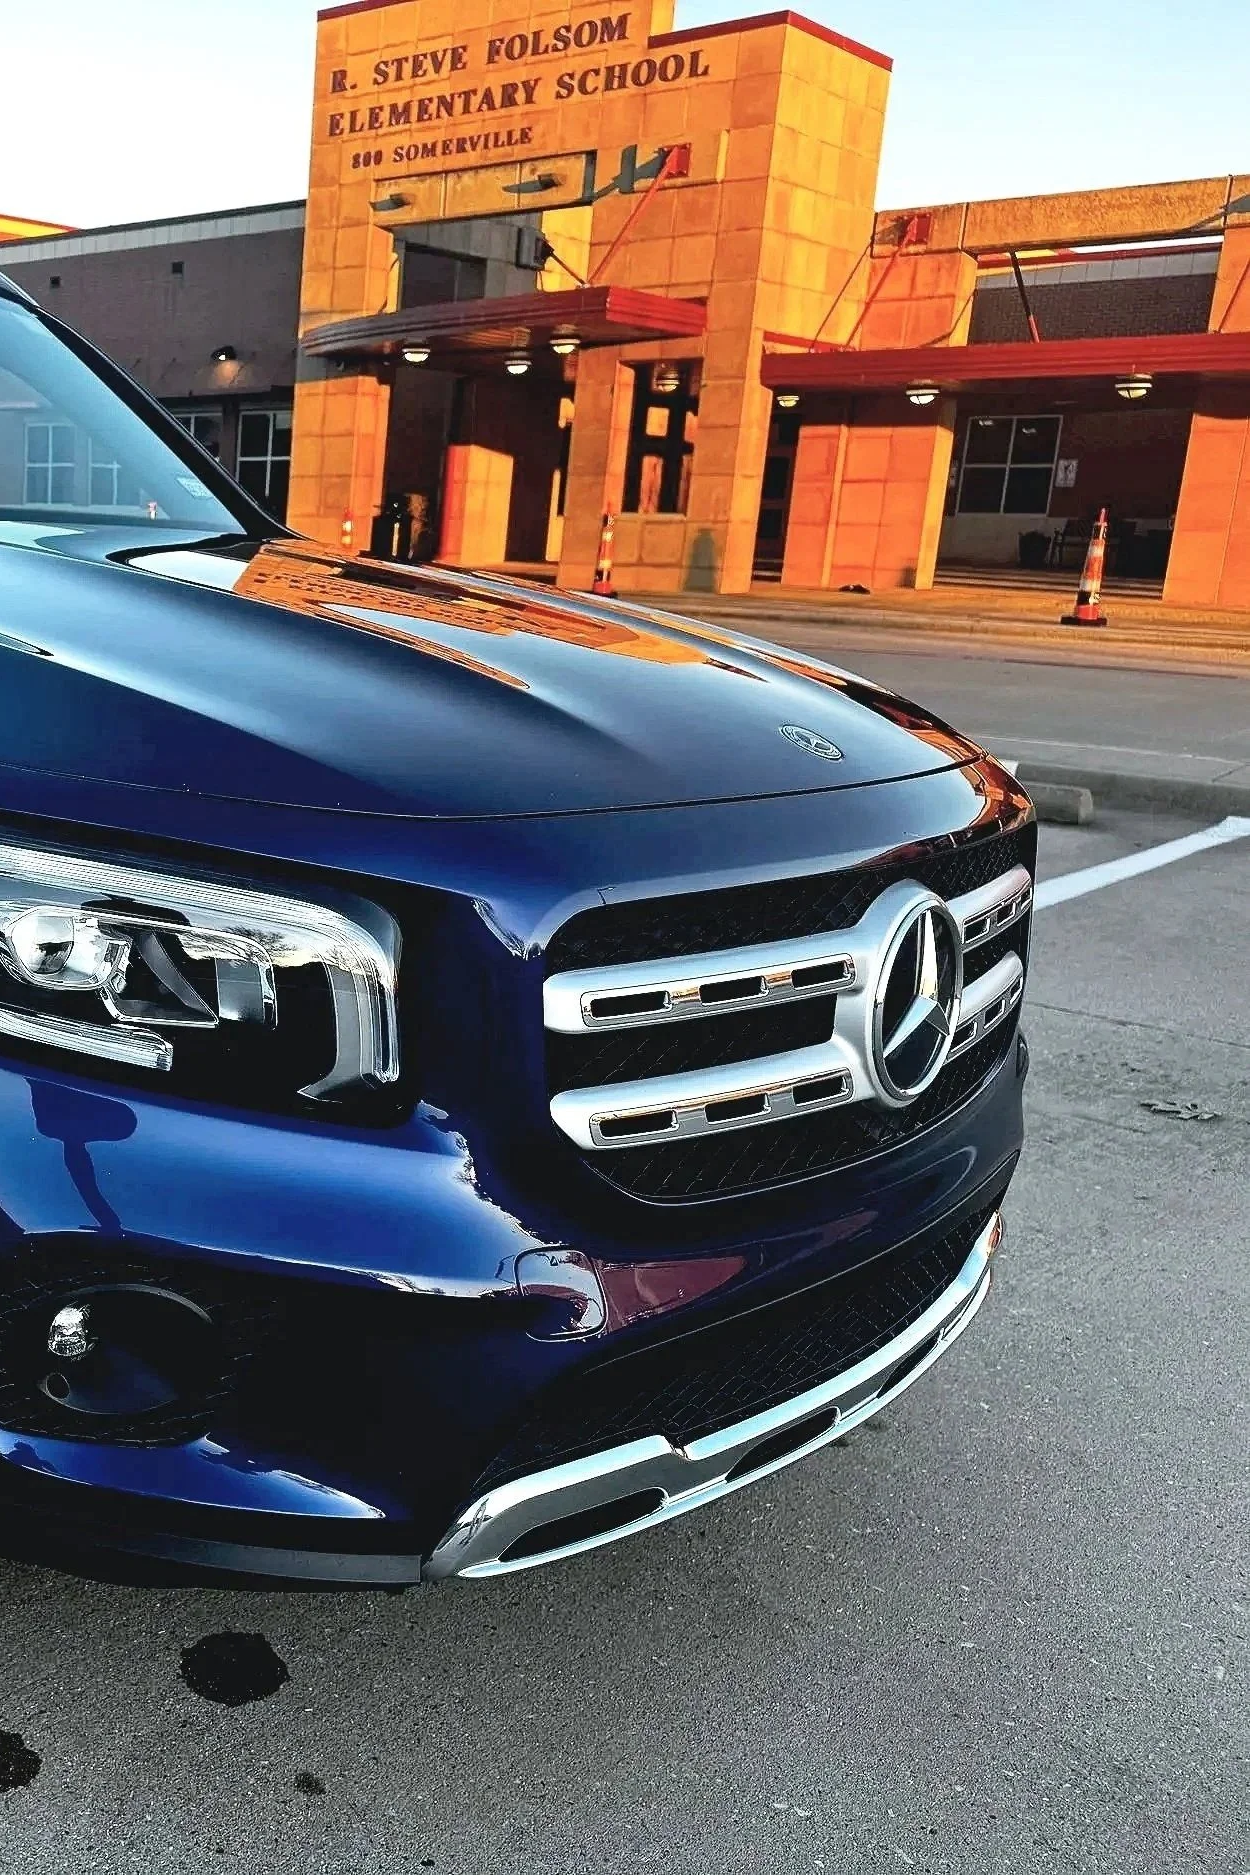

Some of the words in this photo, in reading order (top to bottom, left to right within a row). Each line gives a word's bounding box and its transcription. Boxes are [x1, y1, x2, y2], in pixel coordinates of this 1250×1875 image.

[328, 77, 542, 137] ELEMENTARY
[555, 49, 710, 100] SCHOOL
[330, 69, 358, 93] R.
[372, 45, 468, 86] STEVE
[486, 12, 632, 65] FOLSOM
[352, 150, 383, 169] 800
[392, 126, 533, 163] SOMERVILLE
